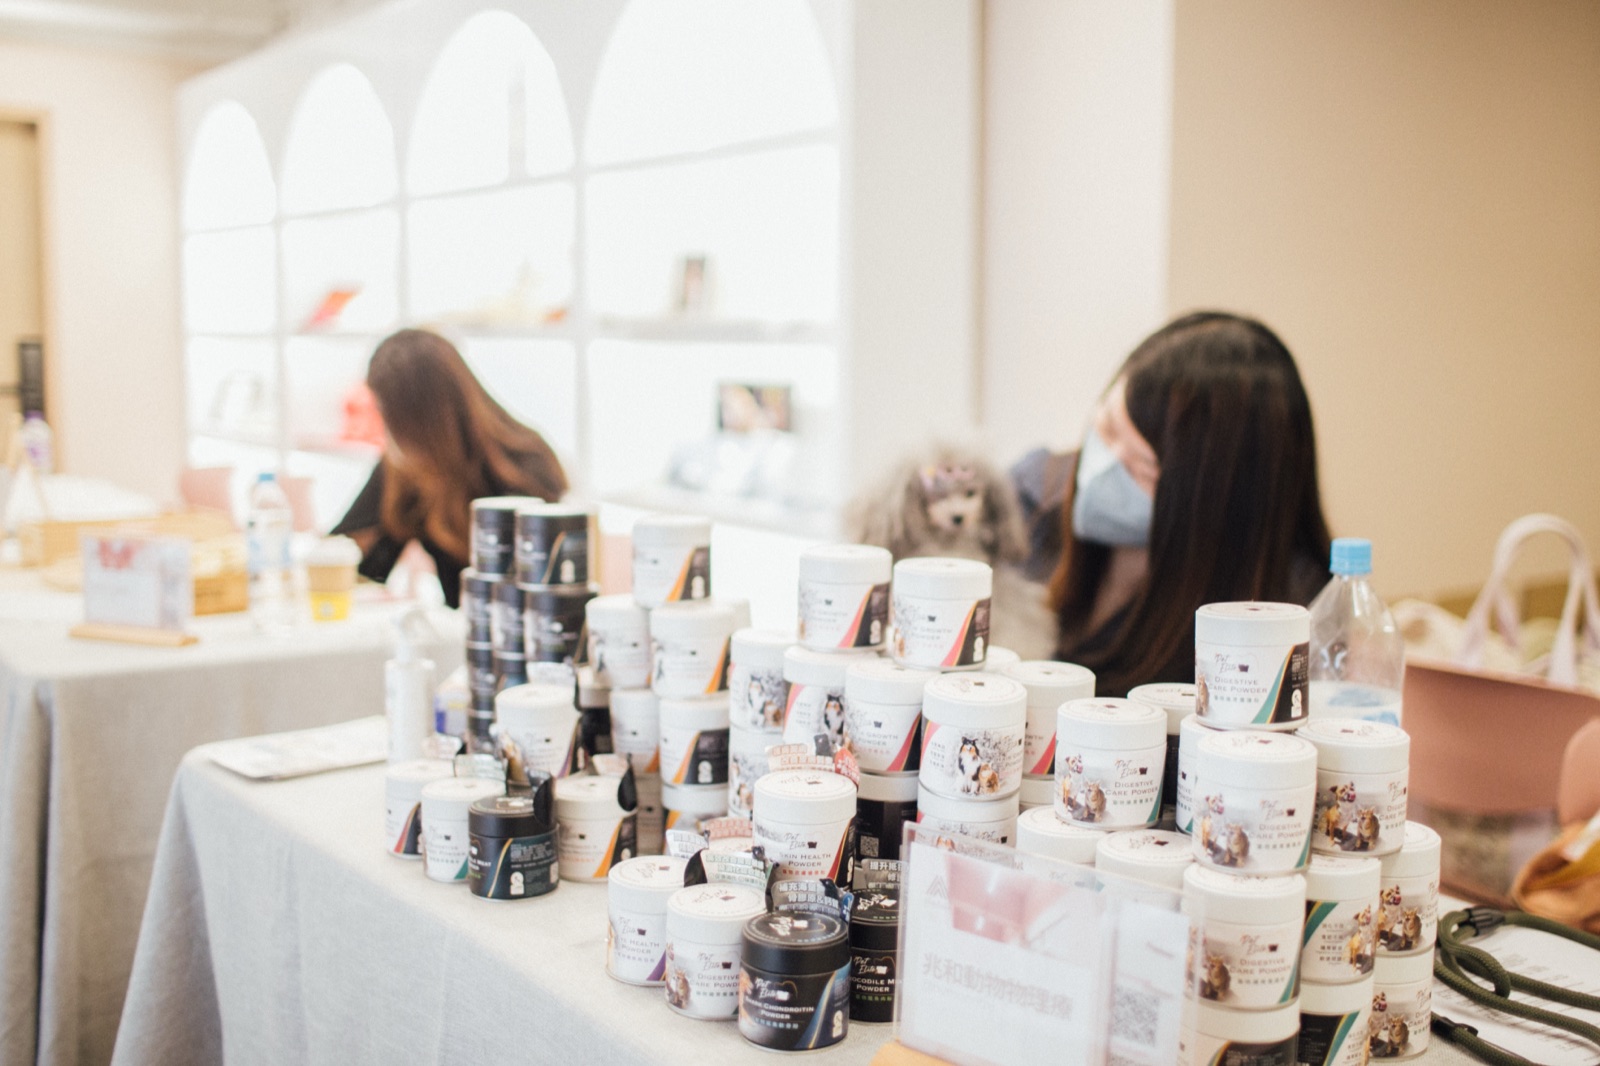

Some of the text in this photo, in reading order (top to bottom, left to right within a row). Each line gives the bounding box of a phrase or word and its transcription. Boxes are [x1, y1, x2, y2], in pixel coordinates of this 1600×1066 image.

[788, 860, 822, 868] POWDER
[856, 984, 890, 993] POWDER
[763, 1003, 815, 1013] CHONDROITIN
[760, 1010, 791, 1020] POWDER
